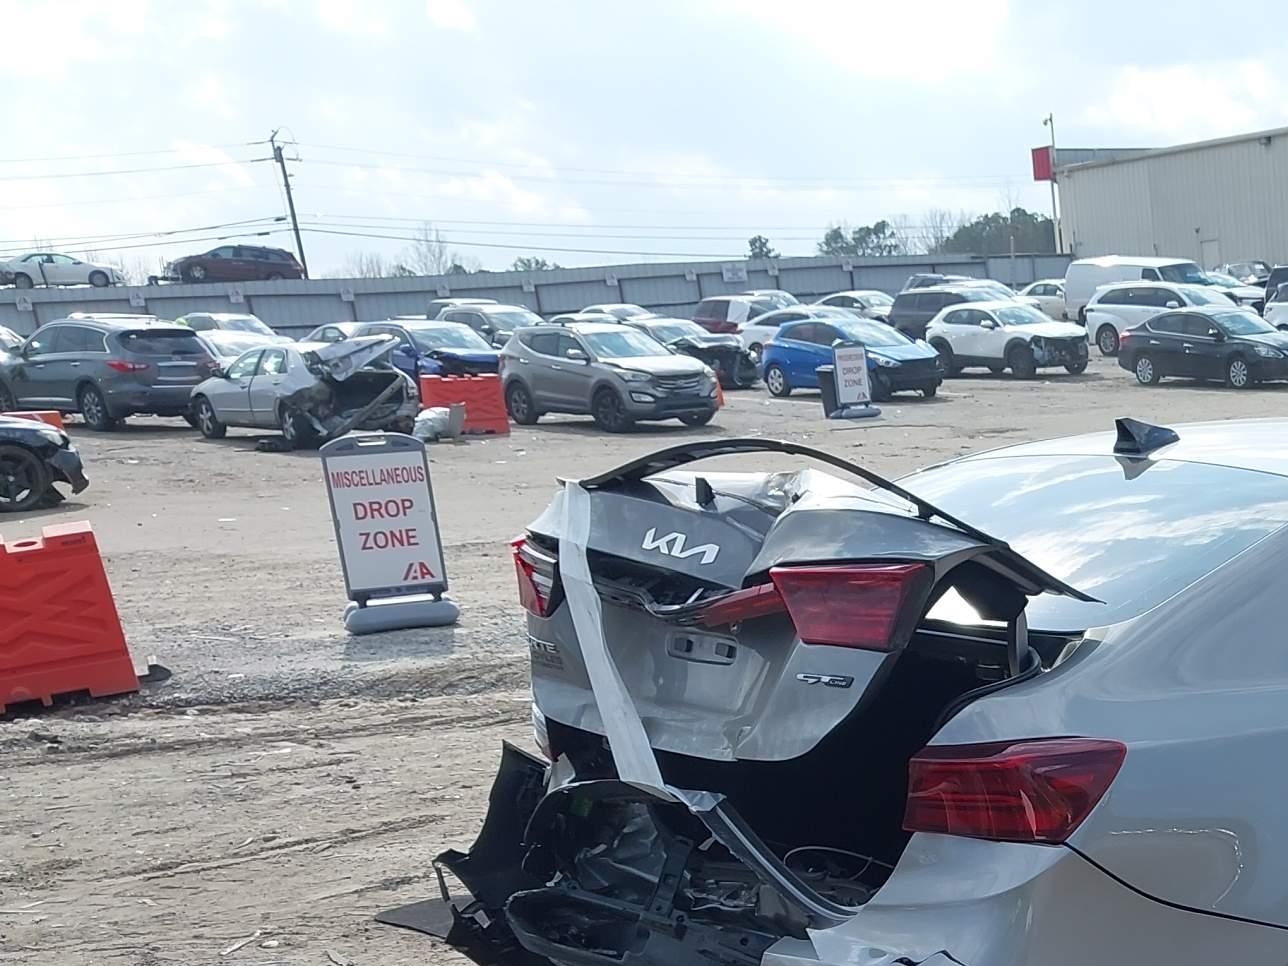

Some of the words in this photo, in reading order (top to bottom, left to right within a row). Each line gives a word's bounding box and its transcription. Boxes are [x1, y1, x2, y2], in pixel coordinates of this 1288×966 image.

[842, 366, 862, 375] DROP
[844, 378, 863, 388] ZONE
[331, 465, 424, 489] MISCELLANEOUS
[352, 498, 414, 521] DROP
[358, 528, 419, 551] ZONE
[641, 527, 720, 564] KIA
